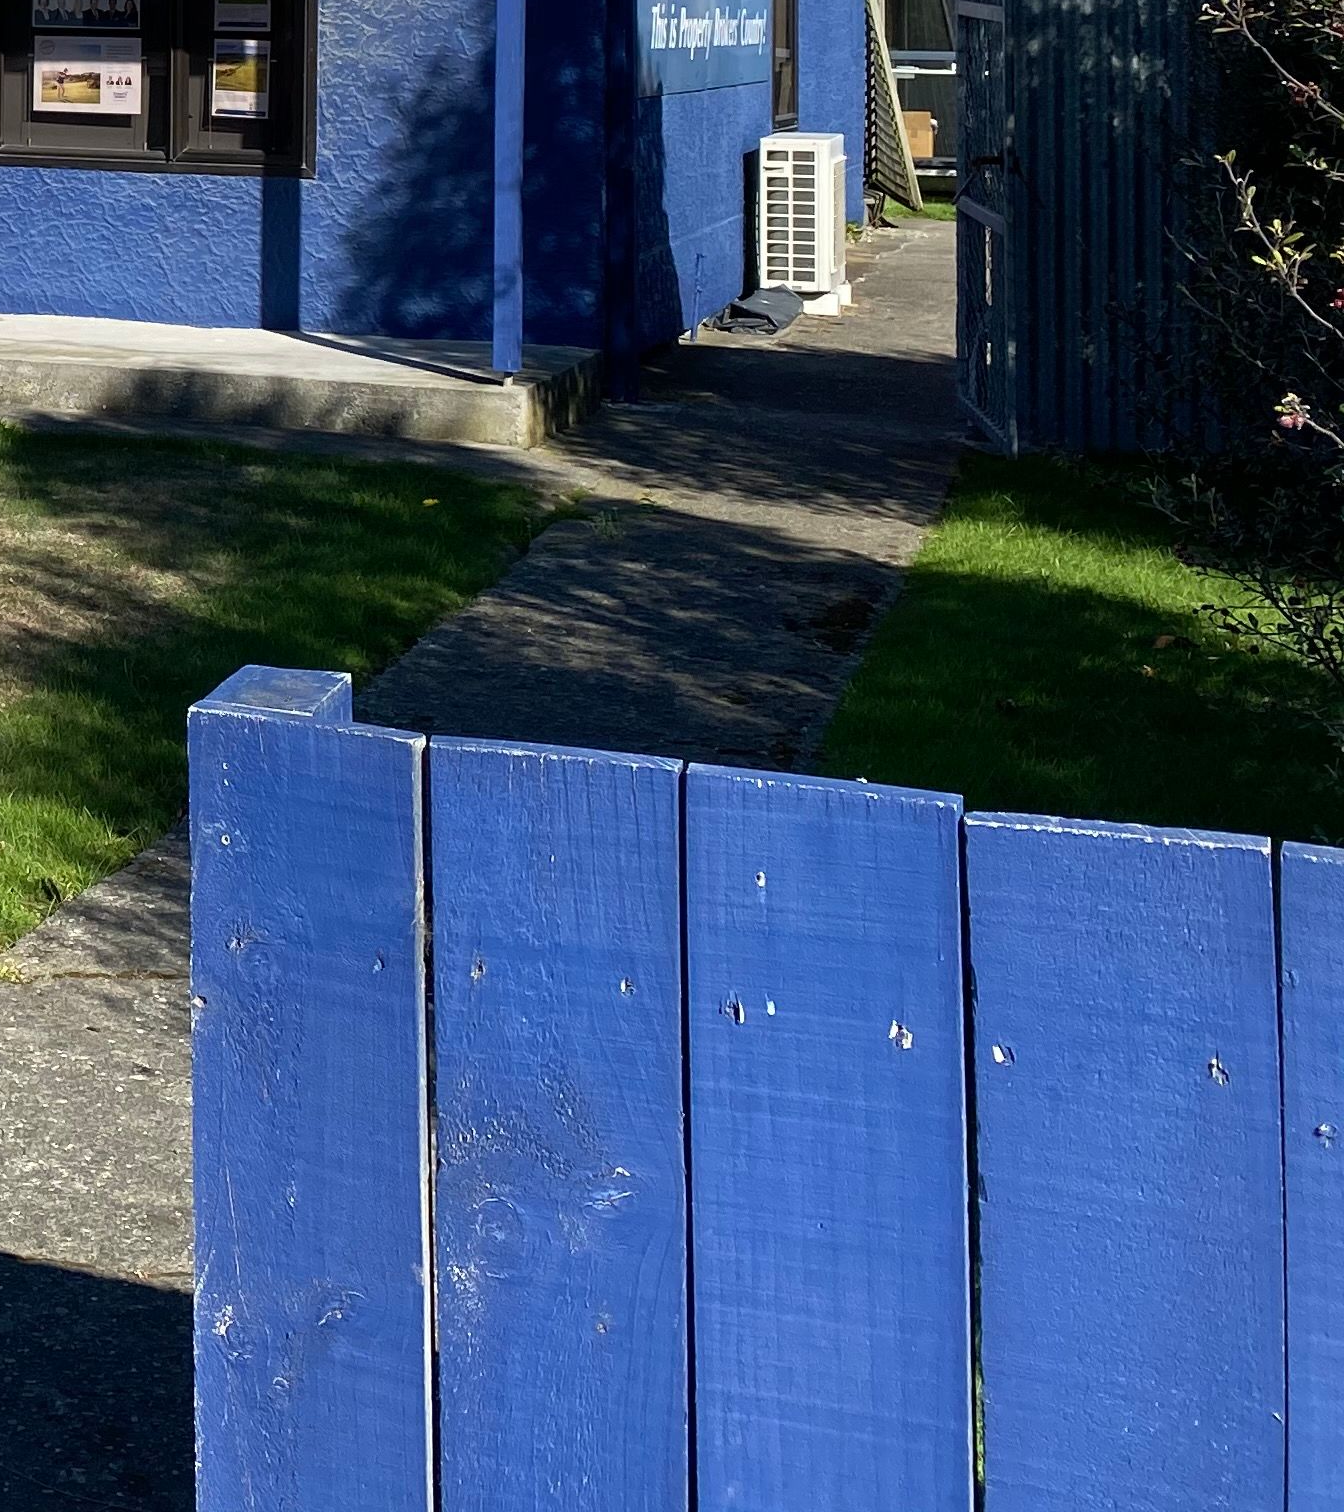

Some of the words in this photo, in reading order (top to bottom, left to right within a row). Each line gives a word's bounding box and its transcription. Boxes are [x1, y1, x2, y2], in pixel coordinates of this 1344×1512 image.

[651, 2, 668, 50] This
[669, 4, 678, 49] is
[679, 6, 713, 61] Property
